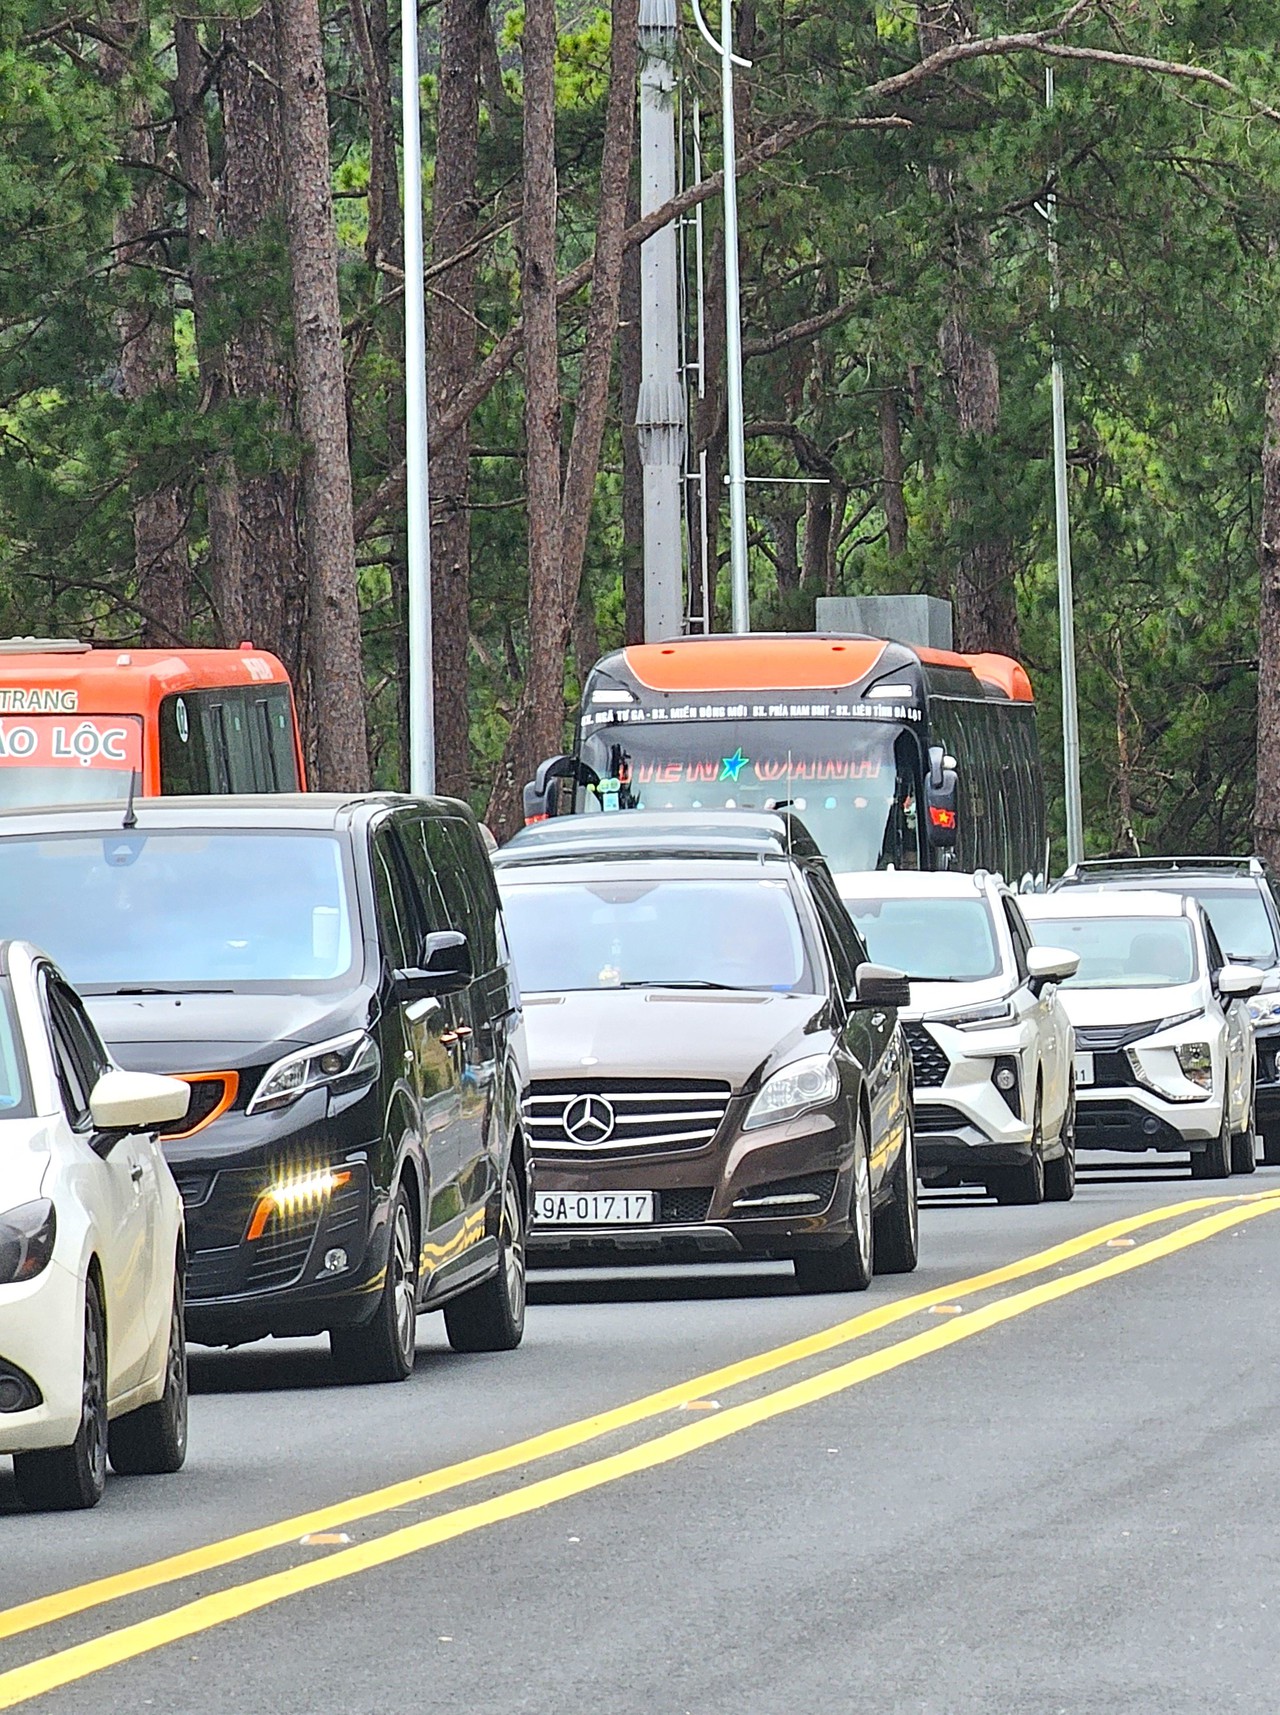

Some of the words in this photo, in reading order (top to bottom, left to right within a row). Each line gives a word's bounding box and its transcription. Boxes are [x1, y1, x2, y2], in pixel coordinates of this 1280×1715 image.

[0, 688, 77, 712] TRANG
[0, 722, 38, 757] O
[52, 722, 127, 766] LỘC
[533, 1196, 647, 1221] 9A-017.17
